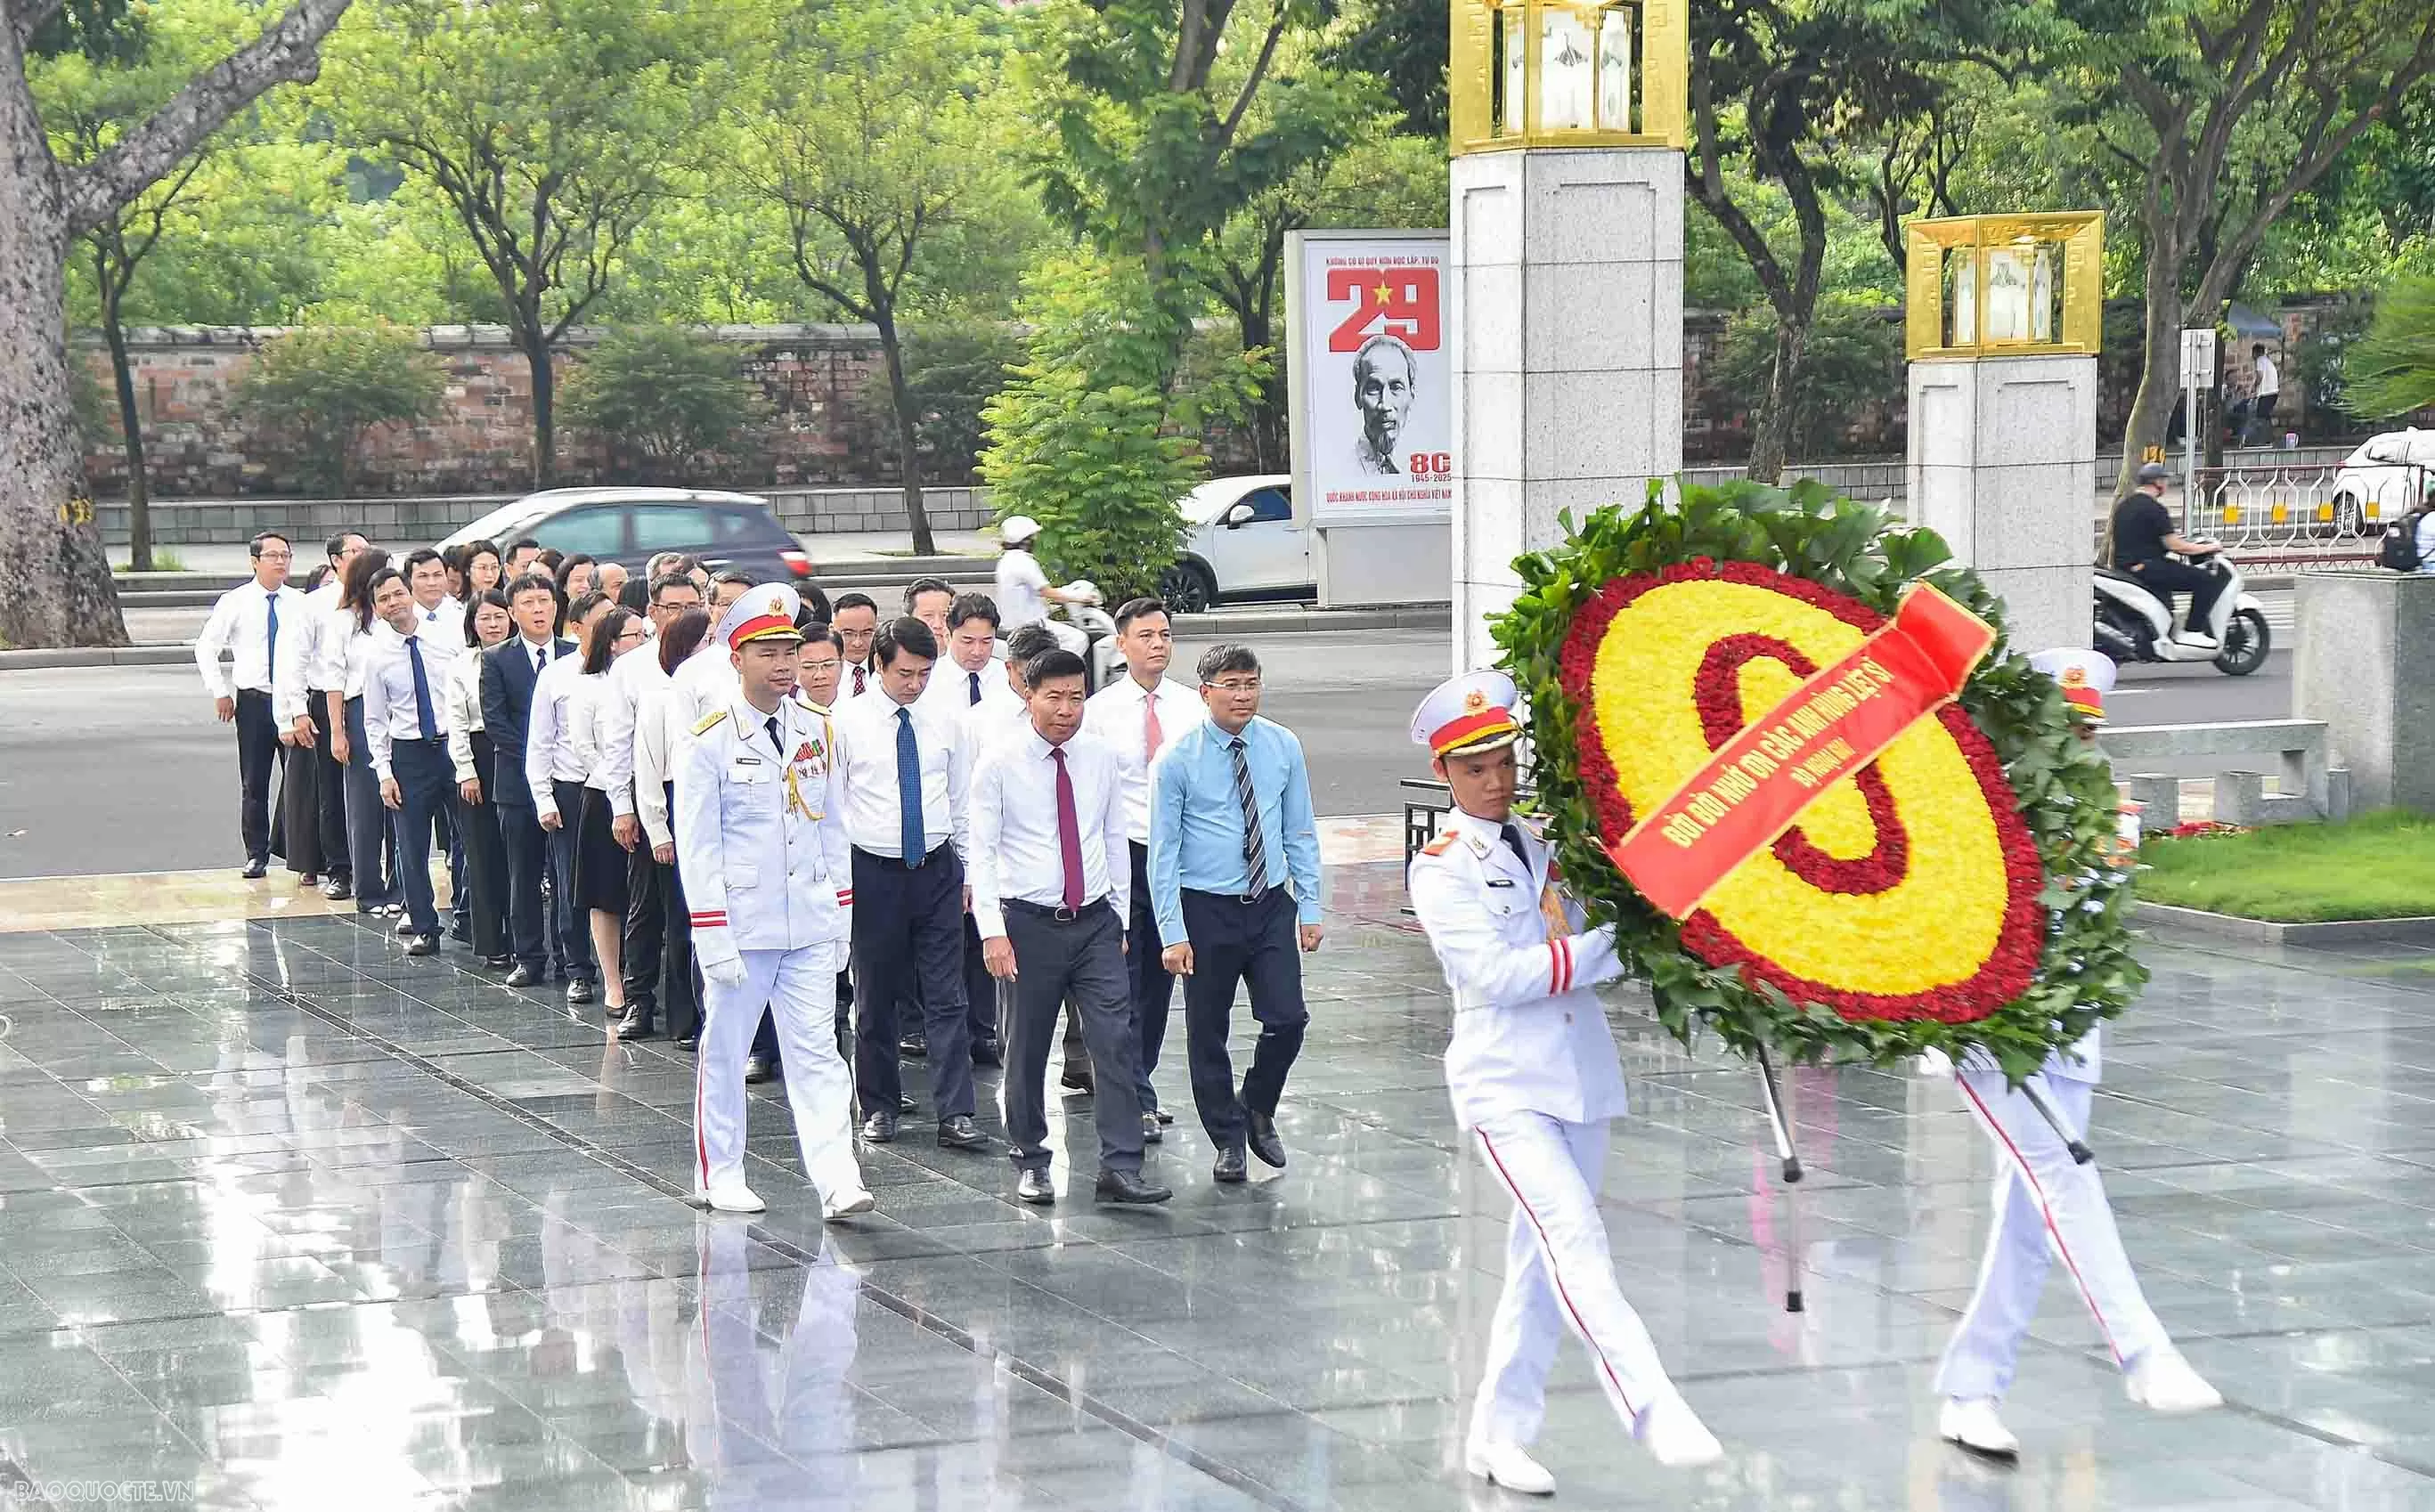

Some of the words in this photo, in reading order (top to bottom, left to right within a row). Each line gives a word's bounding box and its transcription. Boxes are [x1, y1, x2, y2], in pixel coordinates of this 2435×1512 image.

[1326, 267, 1440, 353] 29
[1411, 474, 1452, 483] 1945-2025
[1710, 762, 1758, 805] NHỚ
[1759, 725, 1804, 760] CÁC
[1785, 704, 1830, 739] ANH
